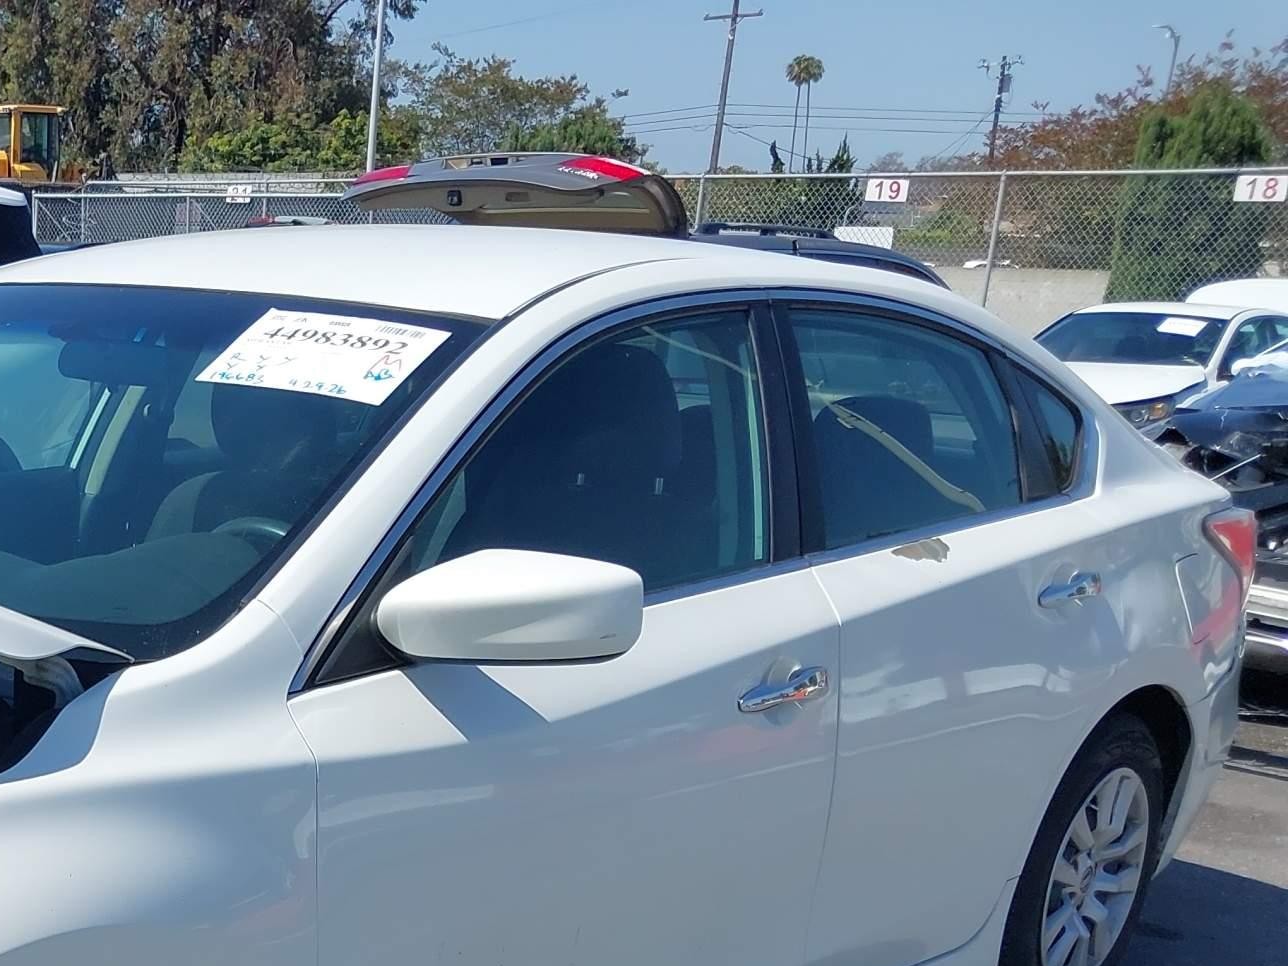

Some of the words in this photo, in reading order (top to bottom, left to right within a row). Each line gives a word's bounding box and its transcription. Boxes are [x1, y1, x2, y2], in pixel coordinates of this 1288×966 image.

[874, 180, 902, 200] 19
[1246, 177, 1278, 200] 18
[264, 326, 409, 355] 44983892
